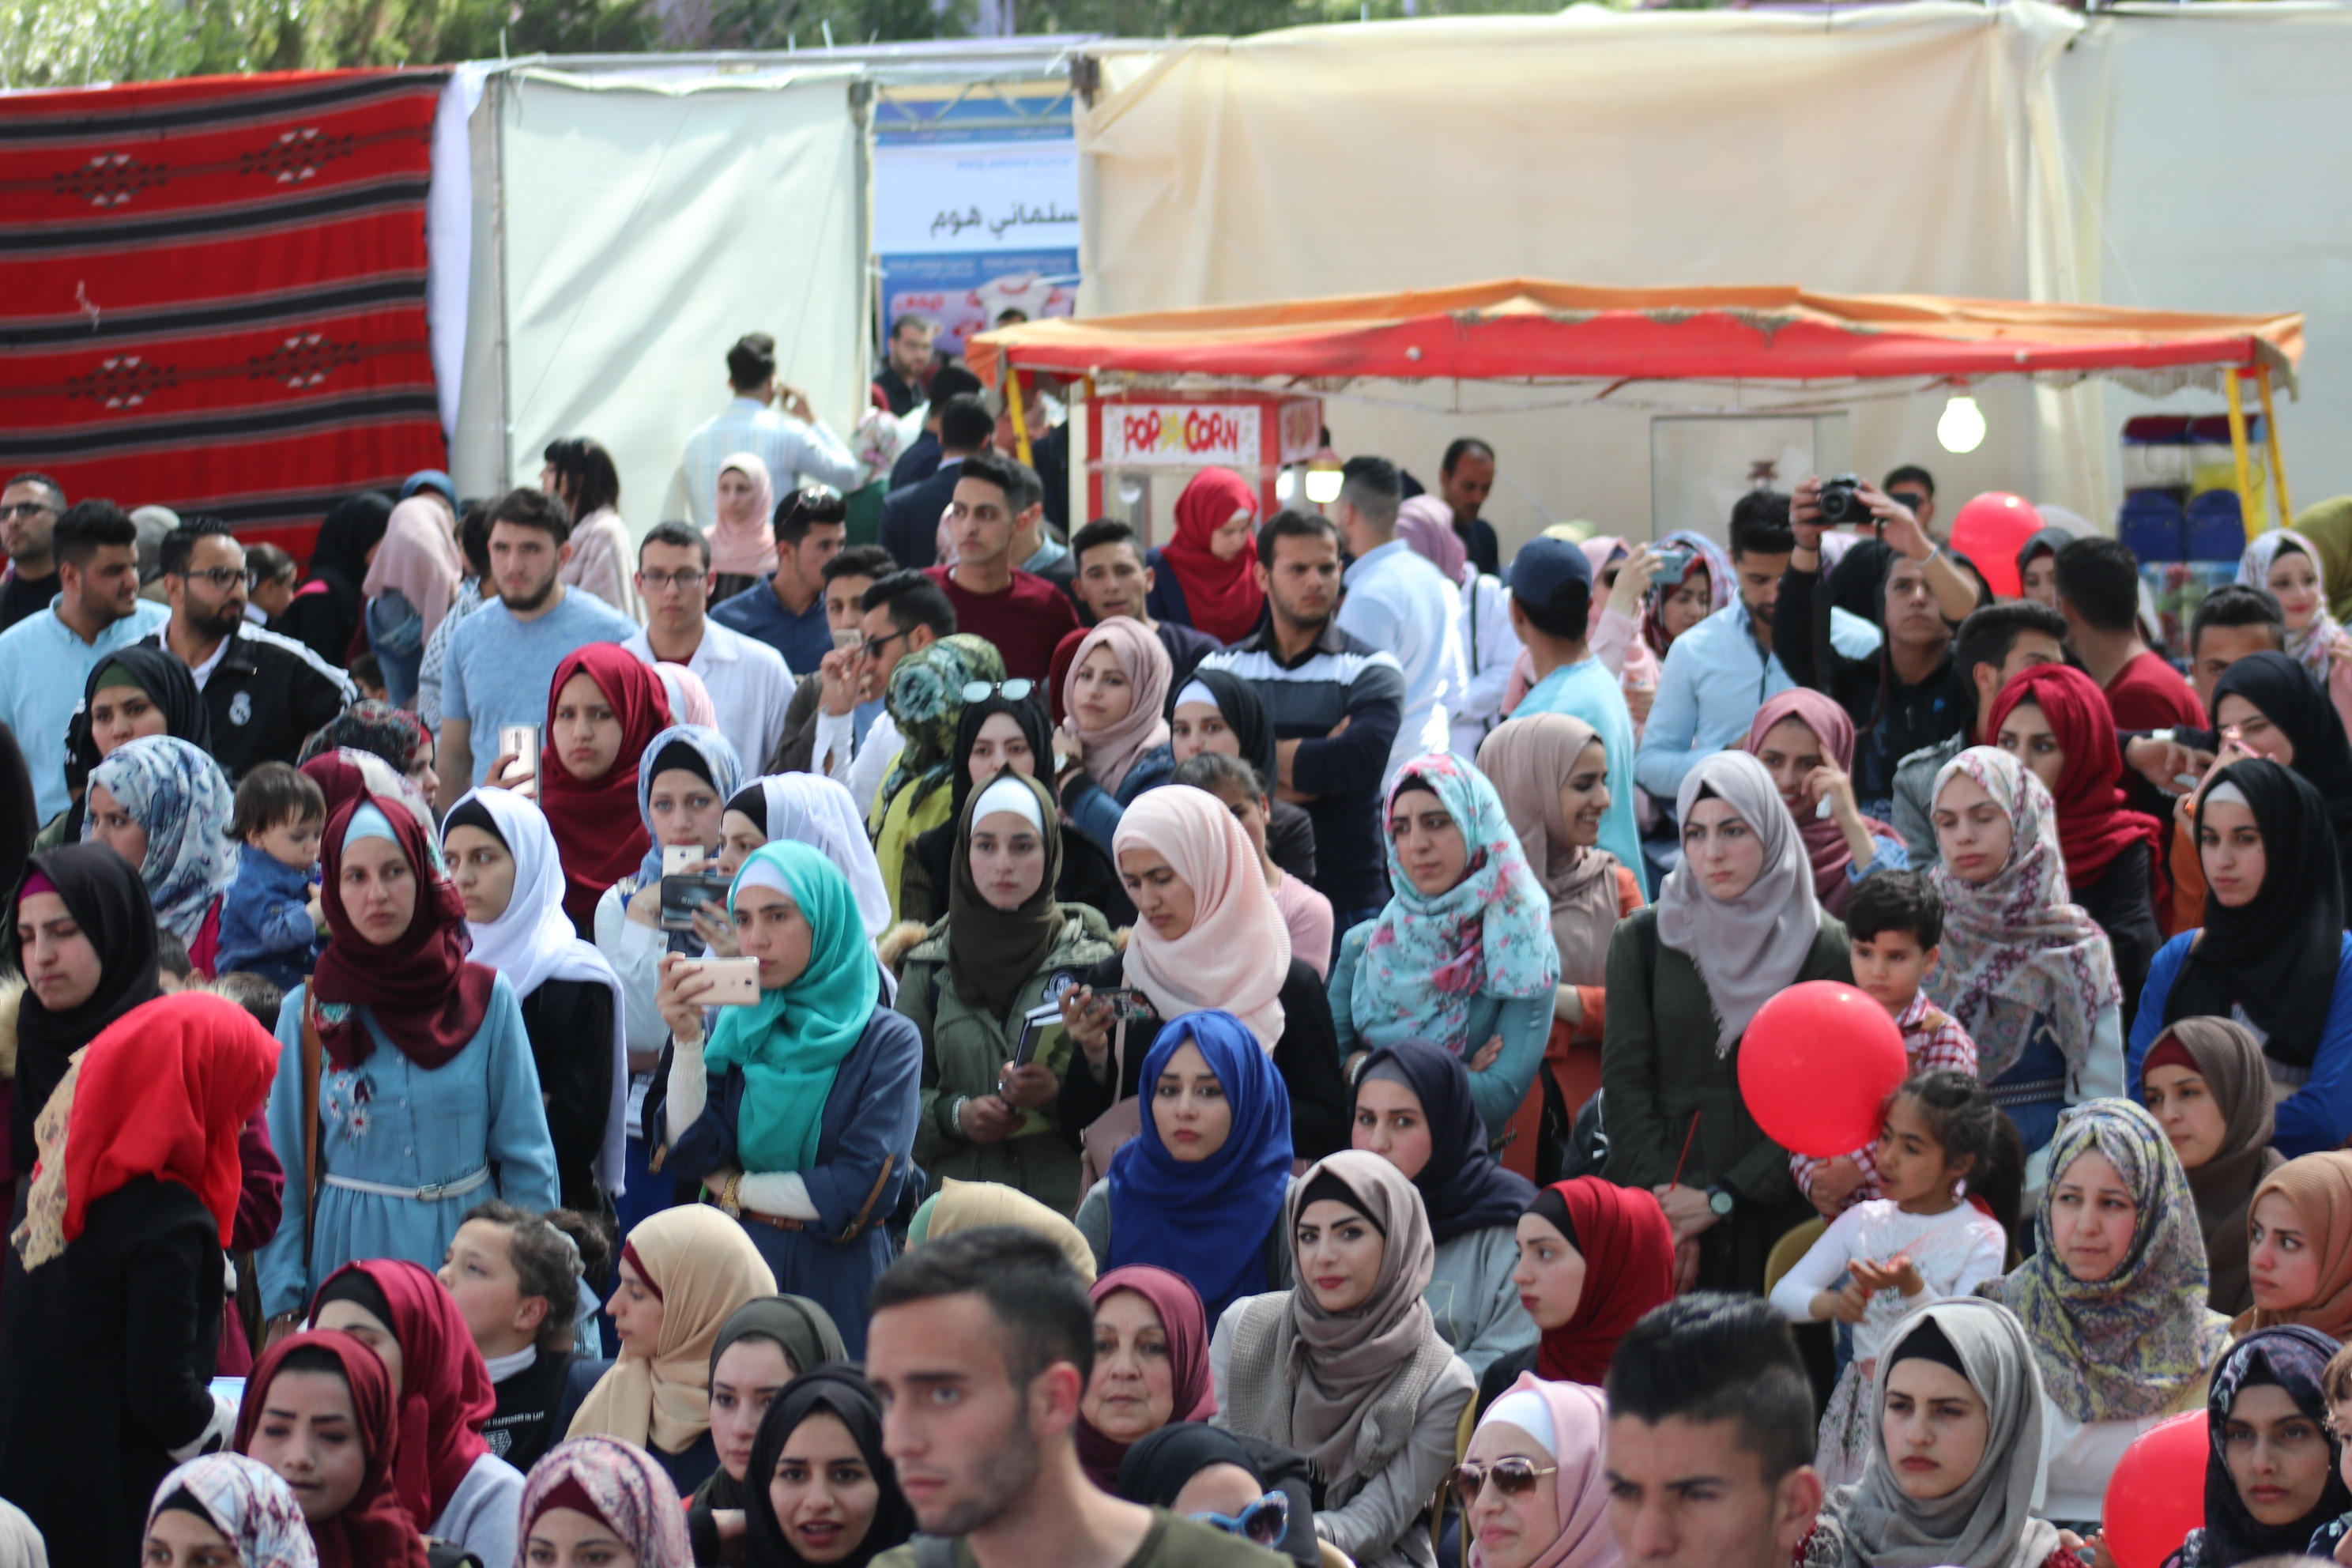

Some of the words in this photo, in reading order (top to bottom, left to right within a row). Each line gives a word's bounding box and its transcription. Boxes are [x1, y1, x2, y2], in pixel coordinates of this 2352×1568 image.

[930, 205, 982, 239] هوم
[1124, 409, 1161, 454] POP
[1185, 409, 1238, 454] CORN
[492, 1413, 524, 1427] HAPPINESS
[525, 1412, 531, 1422] IN
[533, 1410, 545, 1422] LIFE
